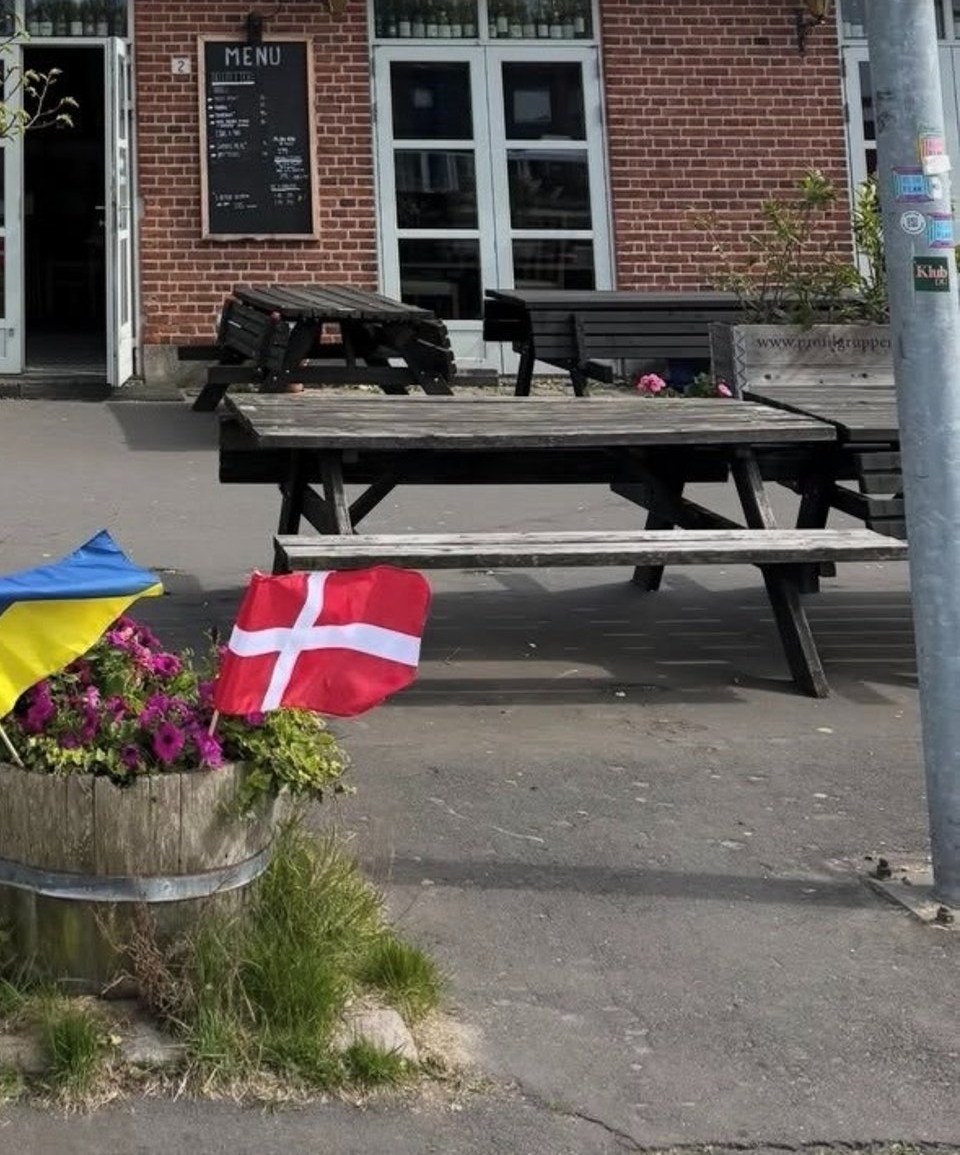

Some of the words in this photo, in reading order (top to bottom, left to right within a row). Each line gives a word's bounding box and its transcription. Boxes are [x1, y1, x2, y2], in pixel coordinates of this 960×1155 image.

[225, 46, 281, 66] MENU
[177, 60, 186, 72] 2
[916, 265, 948, 278] Klub
